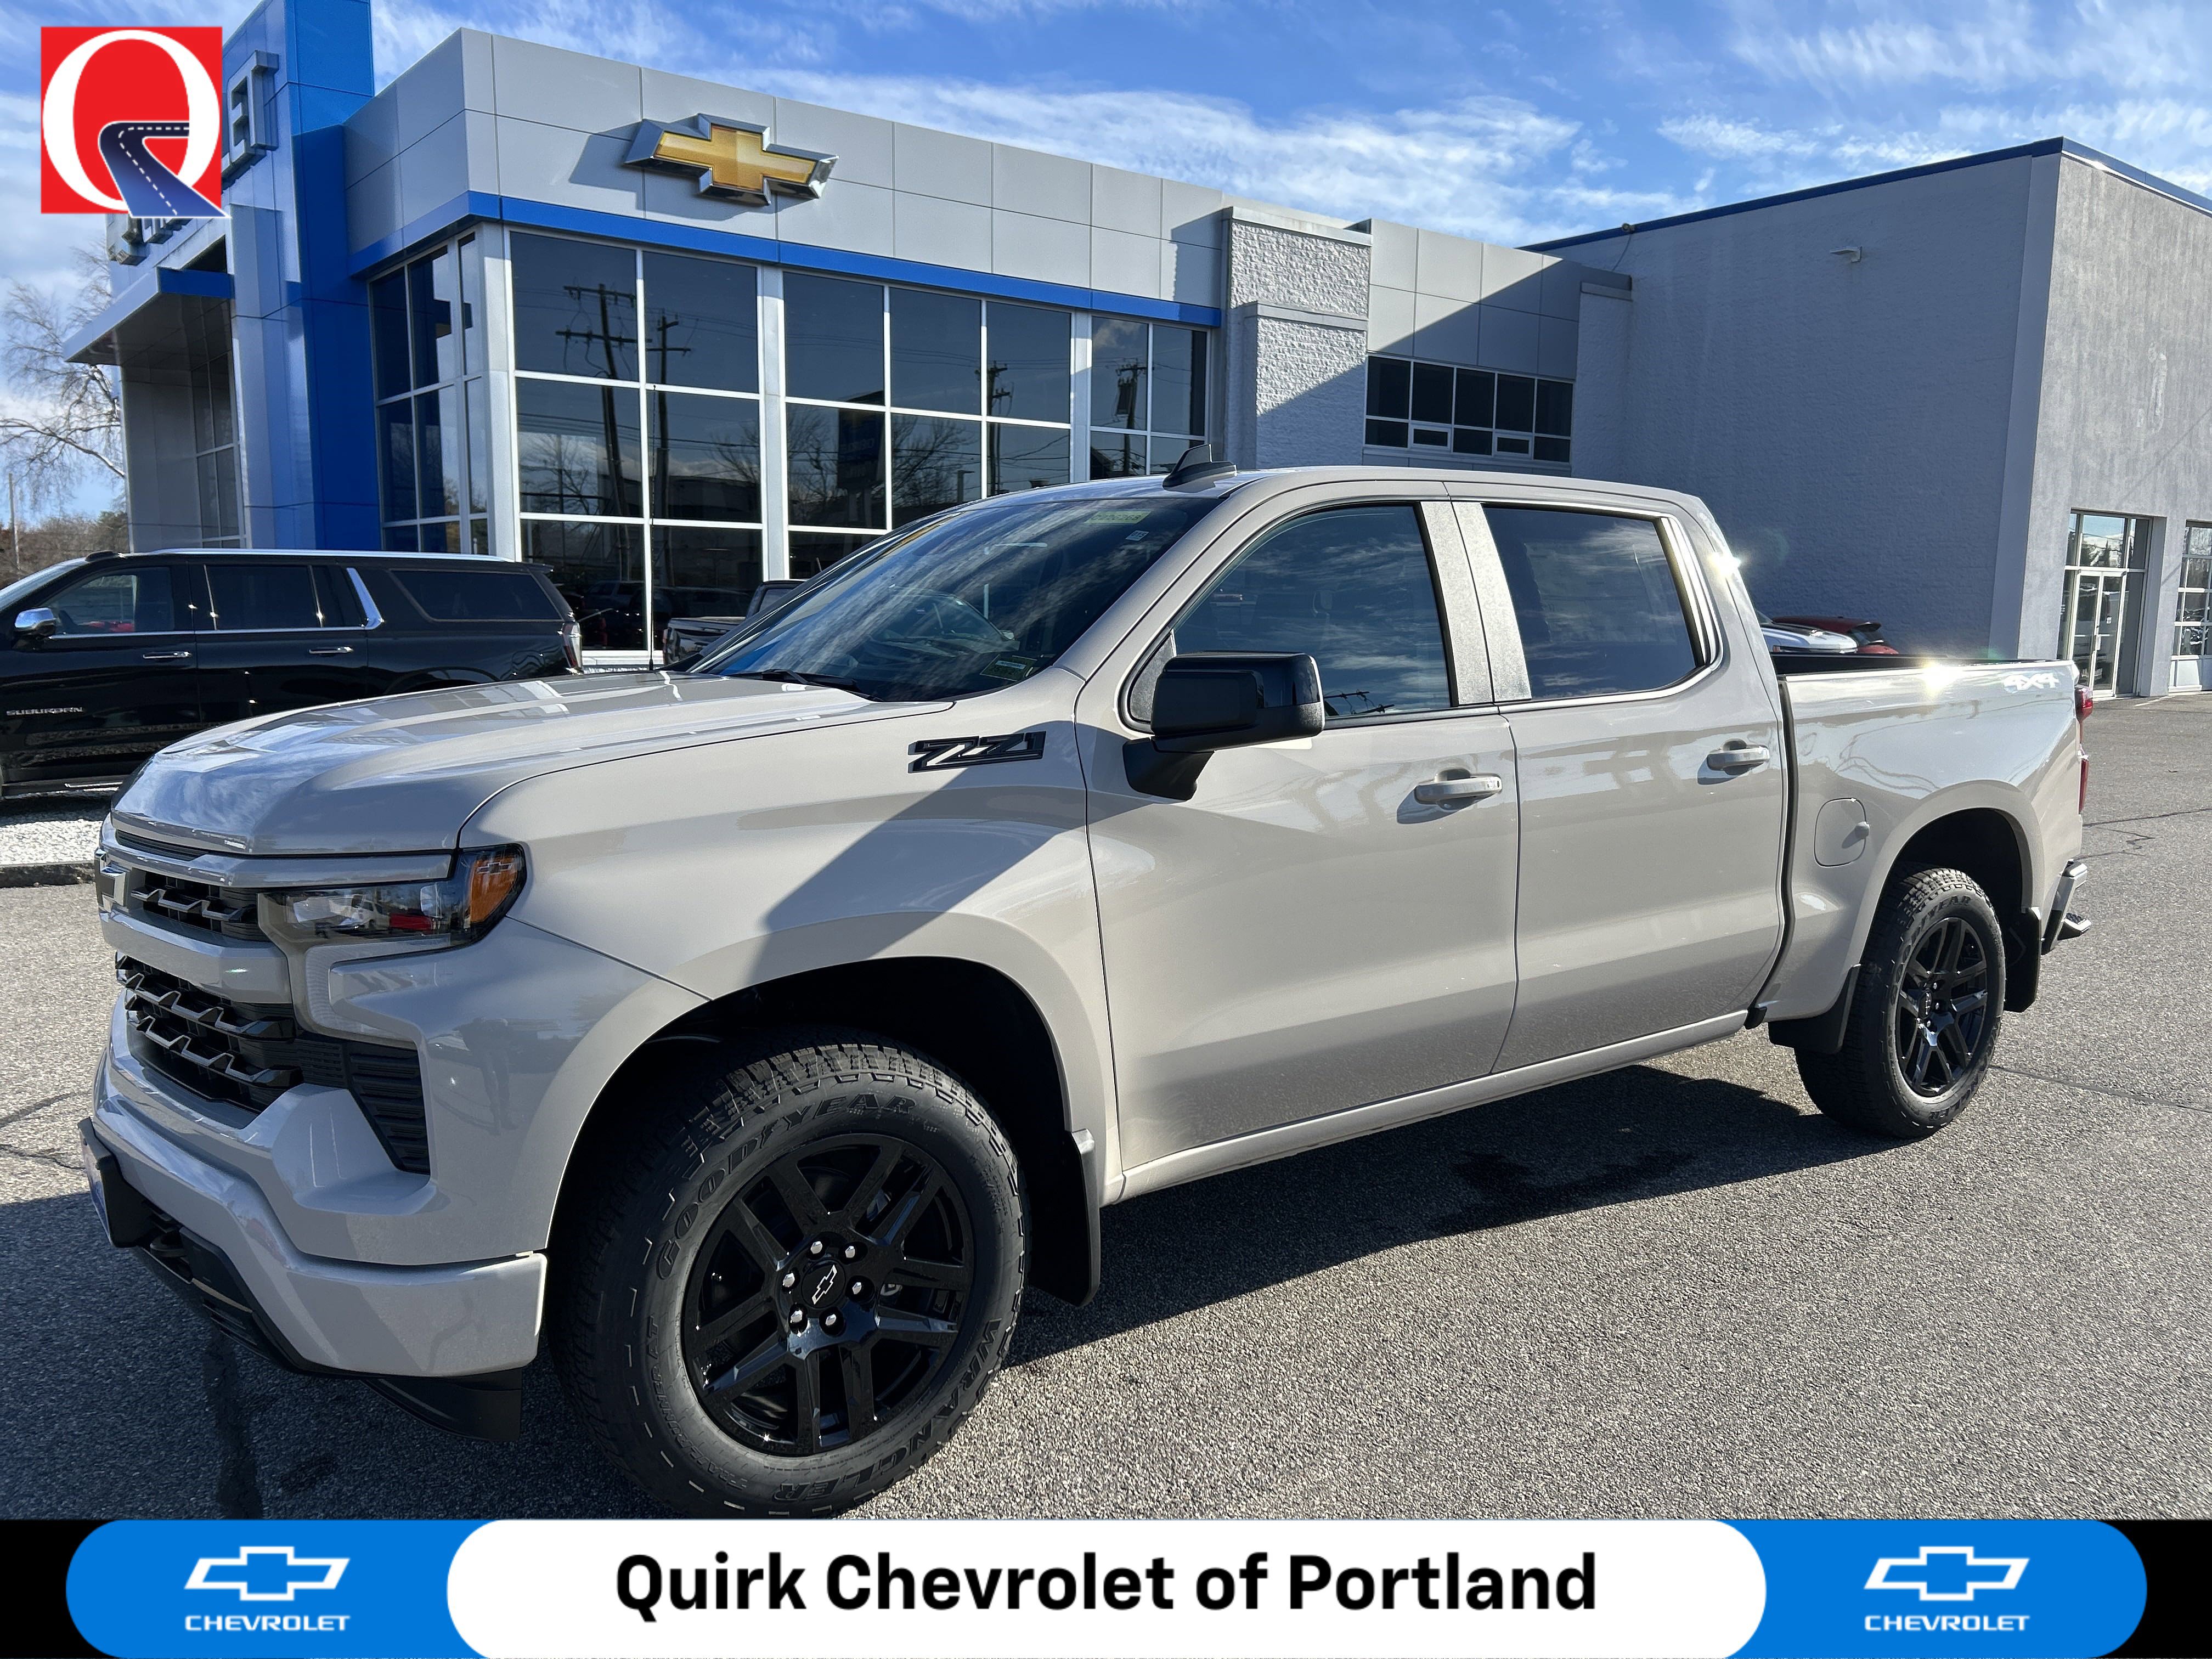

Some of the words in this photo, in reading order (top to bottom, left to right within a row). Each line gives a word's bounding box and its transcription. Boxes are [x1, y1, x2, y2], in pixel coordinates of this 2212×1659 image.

[7, 707, 82, 715] SUBURBAN
[908, 731, 1046, 774] Z71
[657, 1092, 917, 1280] GOODYEAR
[771, 1318, 1002, 1501] WRANGLER
